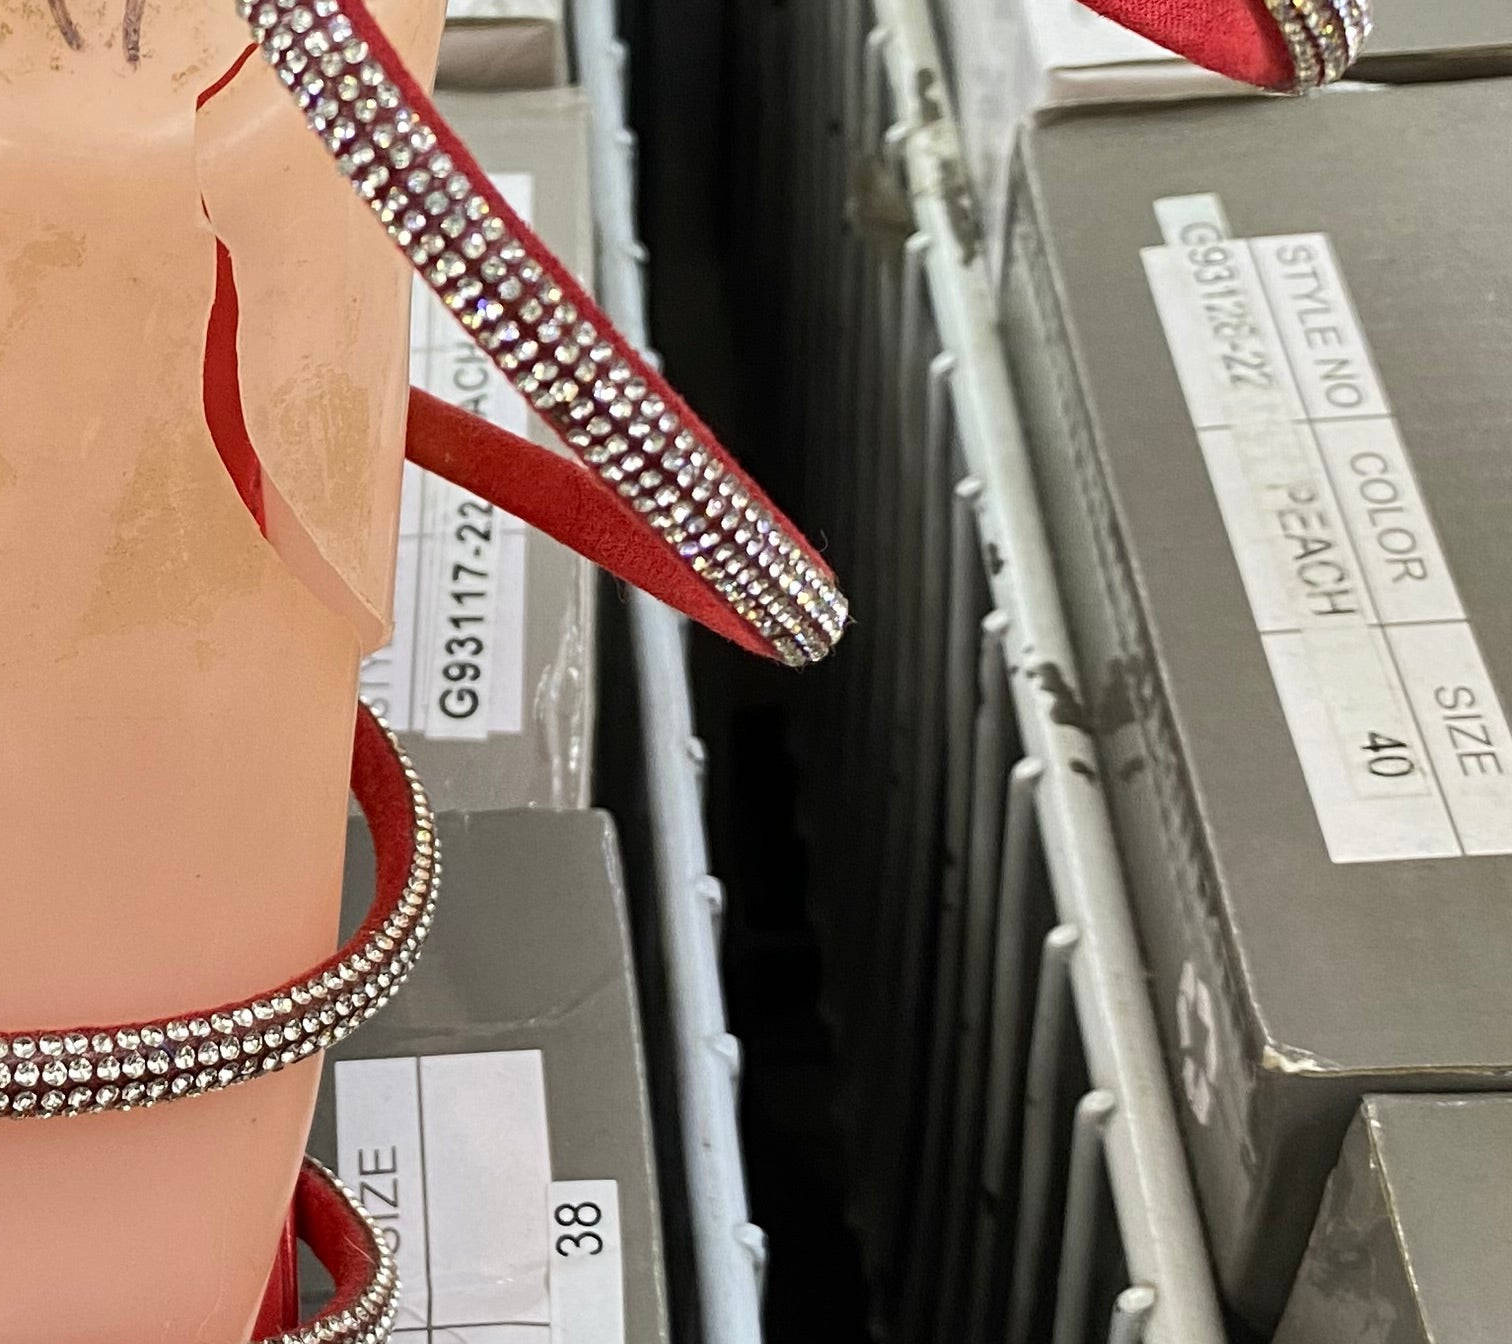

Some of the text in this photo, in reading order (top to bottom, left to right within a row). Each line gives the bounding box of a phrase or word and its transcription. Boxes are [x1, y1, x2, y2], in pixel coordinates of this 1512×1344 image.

[1276, 244, 1364, 409] STYLE NO
[1266, 479, 1357, 616] PEACH
[1350, 451, 1428, 584] COLOR
[439, 499, 494, 719] G93117-22
[1361, 730, 1416, 780] 40
[1434, 685, 1505, 778] SIZE
[554, 1200, 605, 1257] 38
